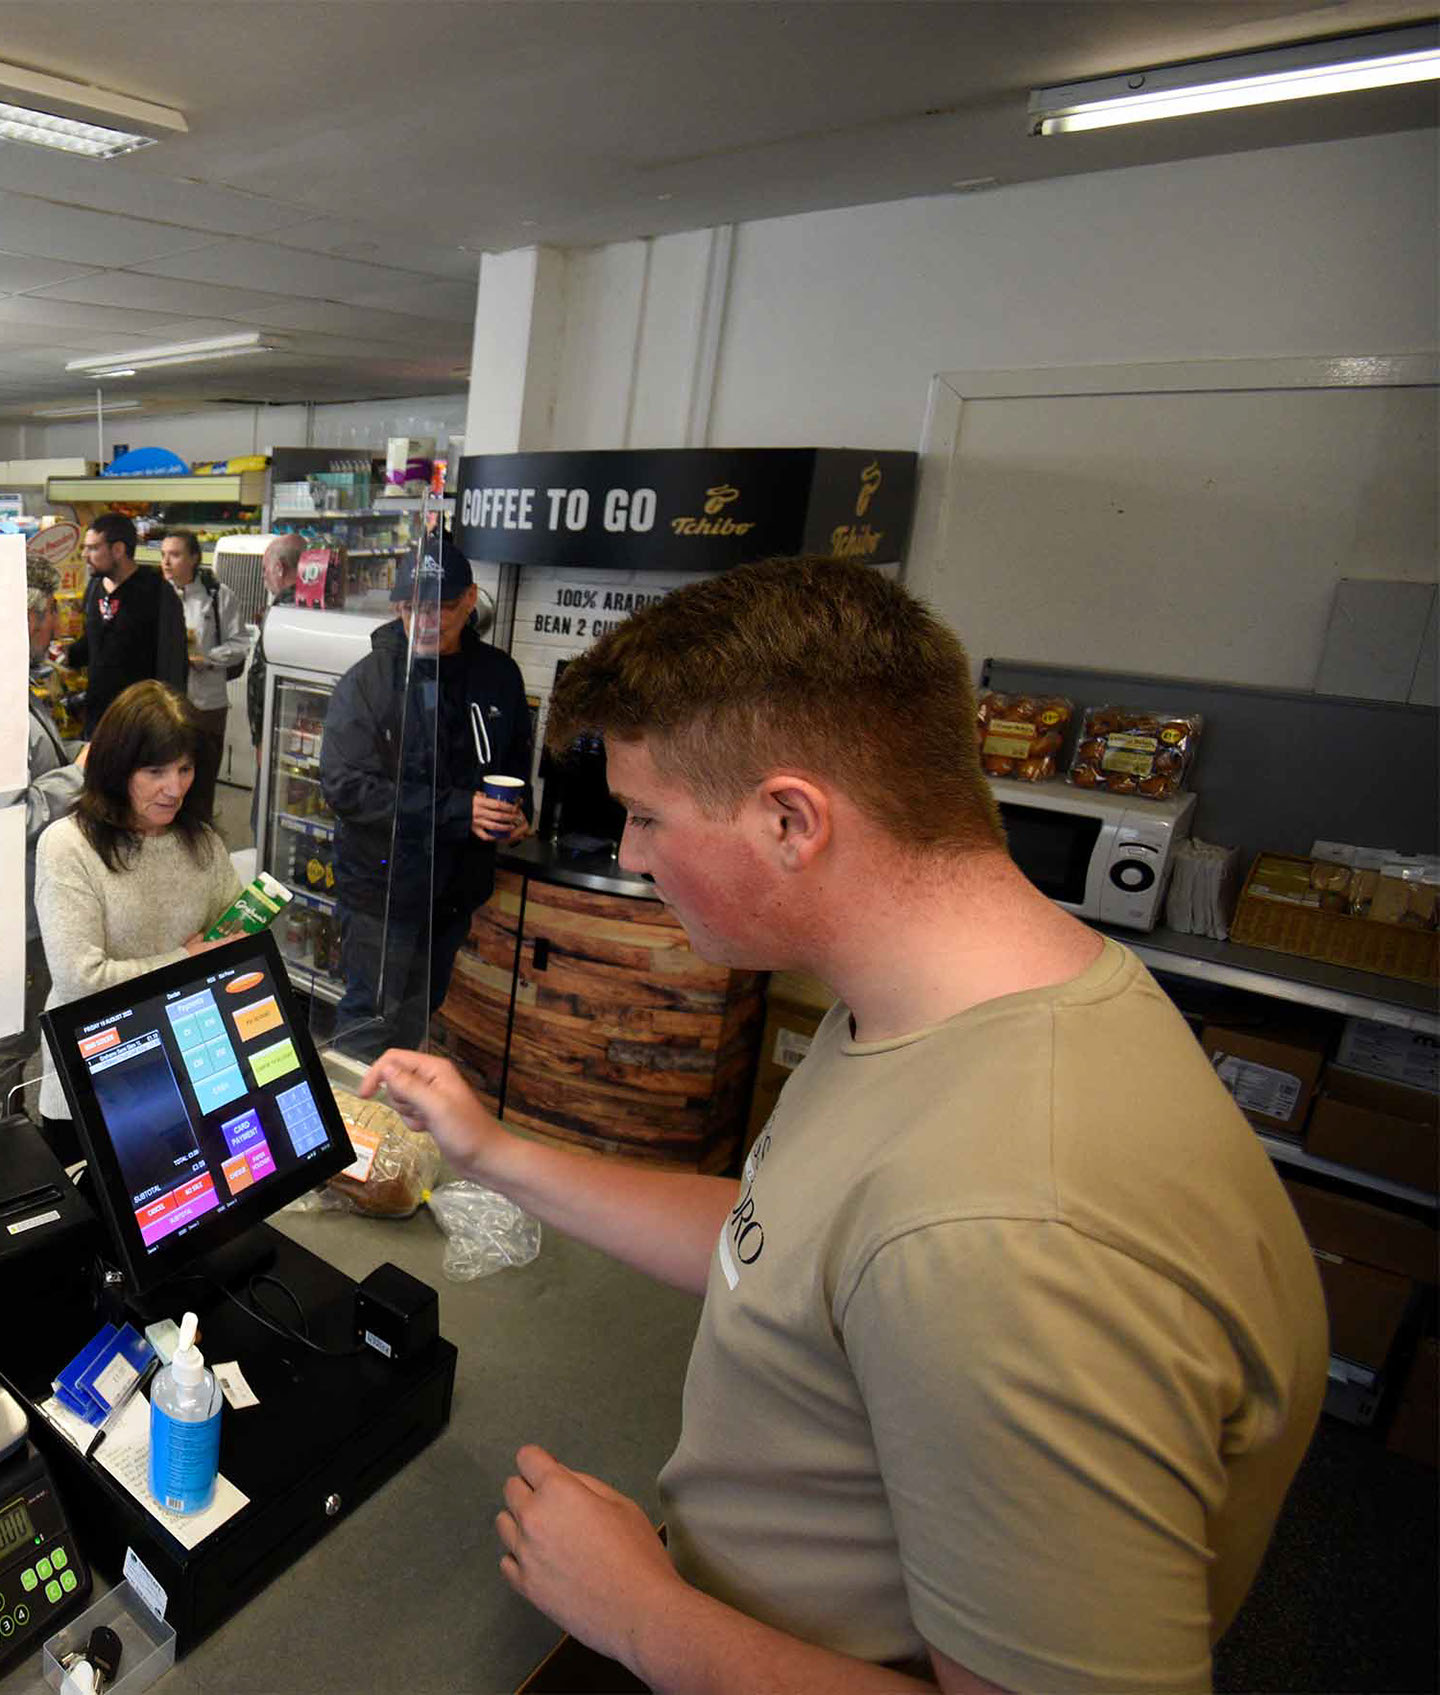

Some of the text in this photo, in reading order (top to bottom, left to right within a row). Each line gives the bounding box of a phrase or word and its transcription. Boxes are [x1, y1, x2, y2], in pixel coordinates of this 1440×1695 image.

[461, 487, 658, 533] COFFEE TO GO
[671, 517, 756, 537] Tchibo
[556, 589, 598, 608] 100%
[534, 614, 572, 635] BEAN
[576, 618, 587, 636] 2
[232, 1127, 258, 1147] PAYMENT
[233, 1120, 250, 1135] CARD
[134, 1184, 161, 1203] SUBTOTAL
[18, 1610, 25, 1619] 4
[3, 1621, 10, 1631] 3
